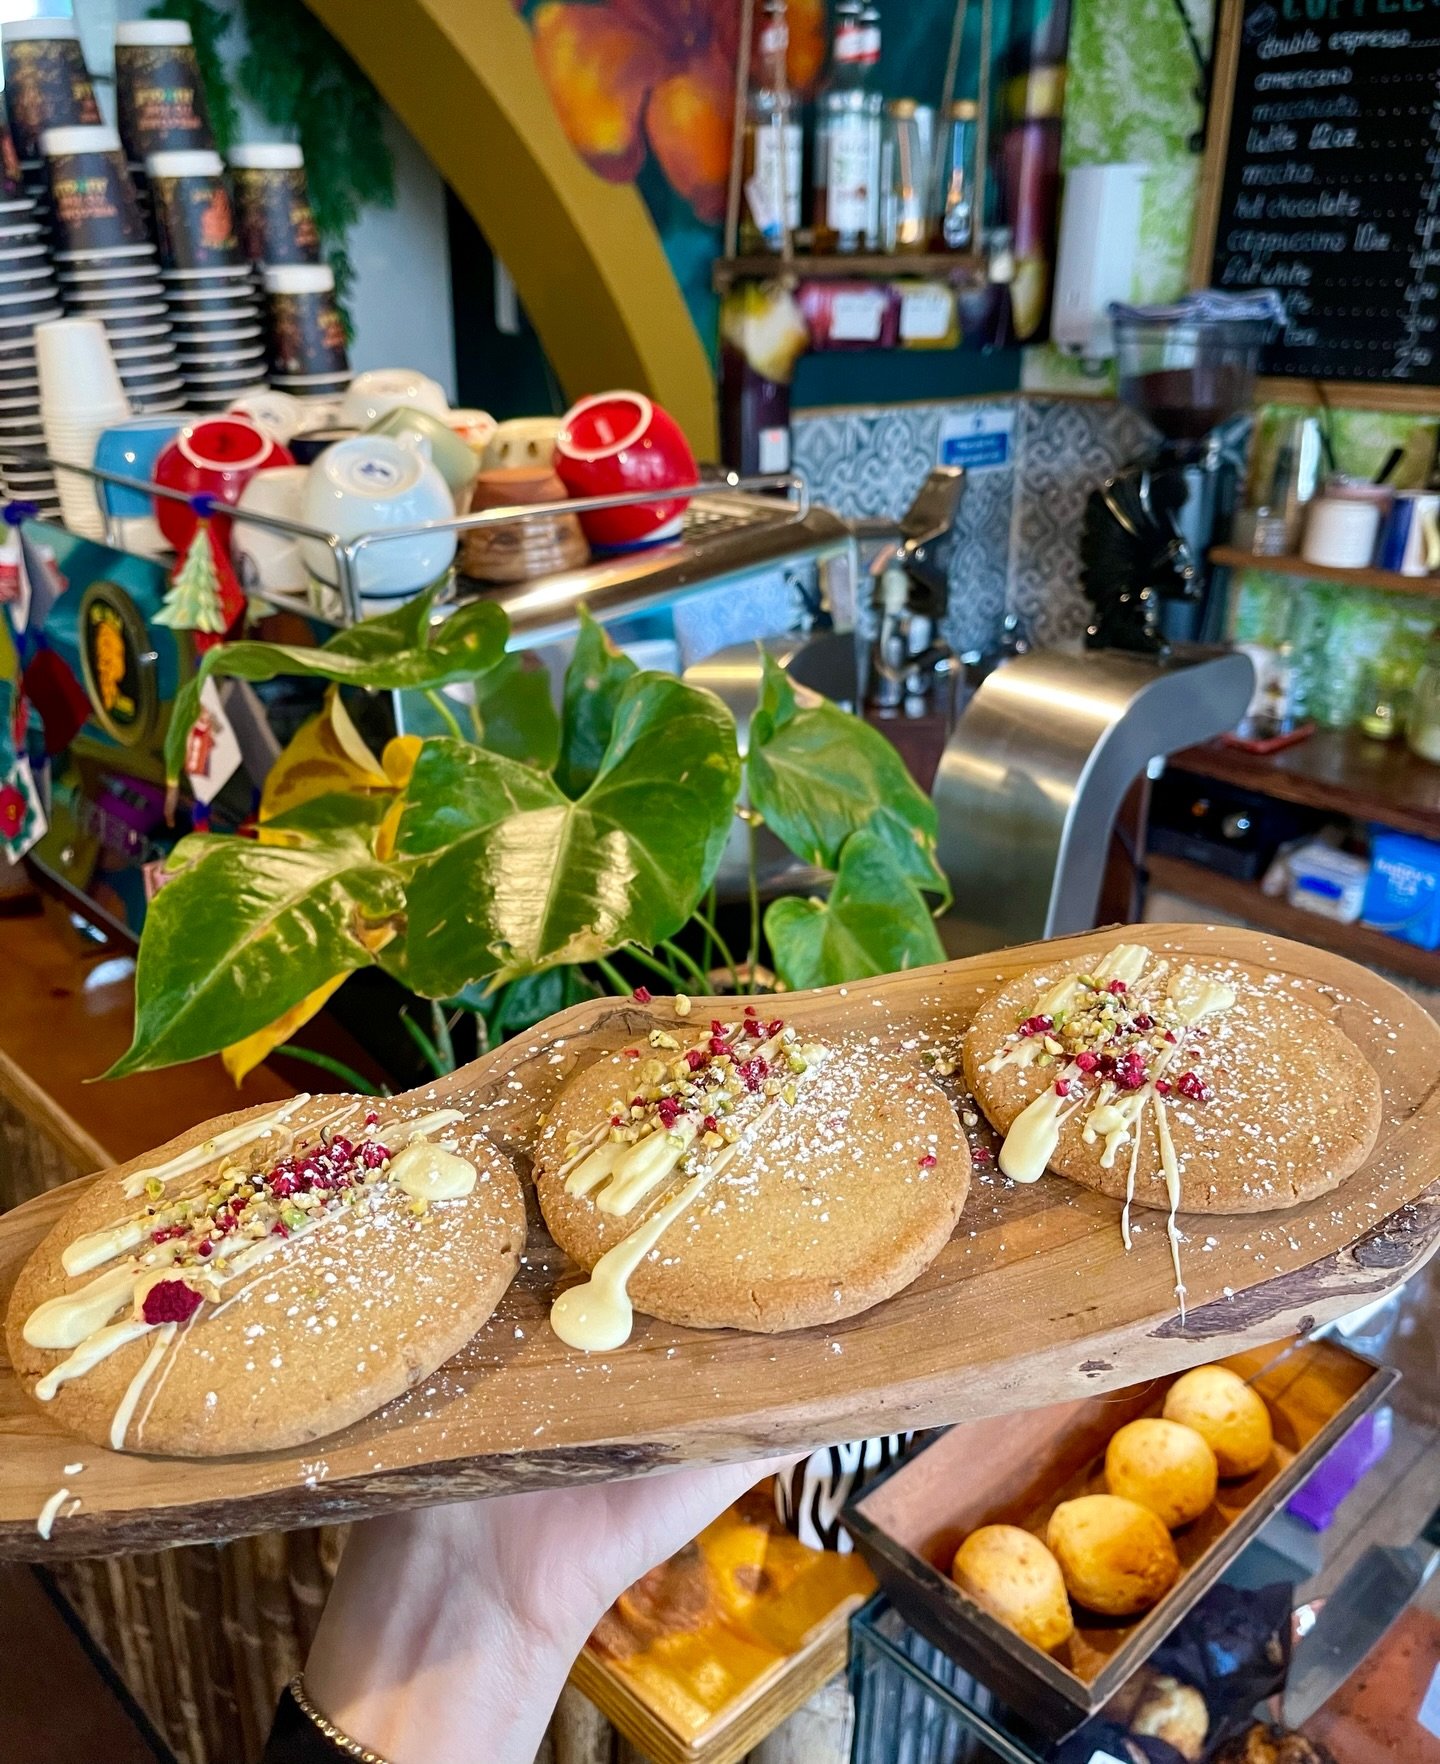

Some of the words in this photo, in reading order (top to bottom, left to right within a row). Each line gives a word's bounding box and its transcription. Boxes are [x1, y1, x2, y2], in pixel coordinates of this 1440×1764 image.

[1257, 29, 1321, 59] double
[1328, 29, 1411, 55] espresso
[1254, 66, 1353, 91] americano
[1242, 161, 1314, 186] mocha
[1266, 189, 1361, 218] chocolate
